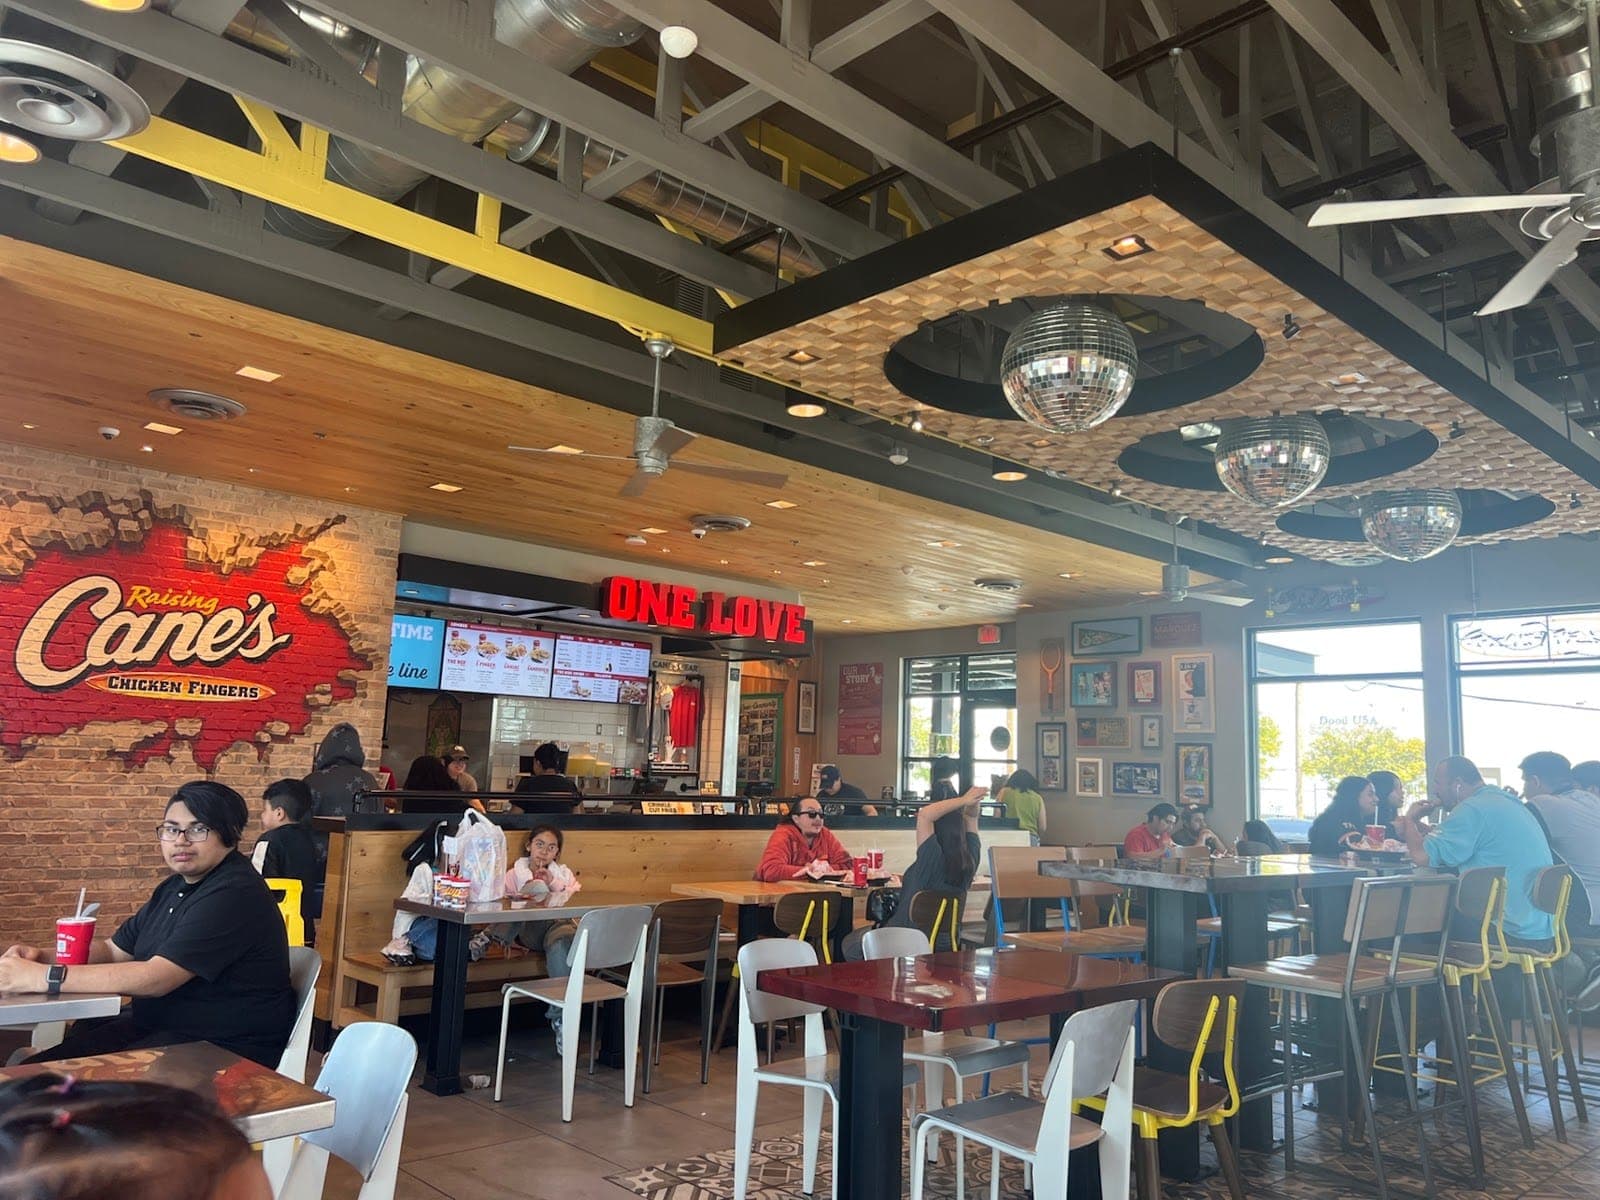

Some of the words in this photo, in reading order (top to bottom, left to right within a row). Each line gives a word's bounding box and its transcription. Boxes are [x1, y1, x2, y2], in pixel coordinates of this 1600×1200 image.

[127, 585, 220, 615] Raising
[604, 575, 697, 630] ONE
[706, 591, 806, 644] LOVE
[15, 575, 291, 689] Cane's
[391, 621, 434, 641] TIME
[399, 661, 428, 679] line
[843, 666, 858, 675] OUR
[846, 674, 870, 684] STORY
[108, 676, 181, 693] CHICKEN
[188, 682, 259, 699] FINGERS
